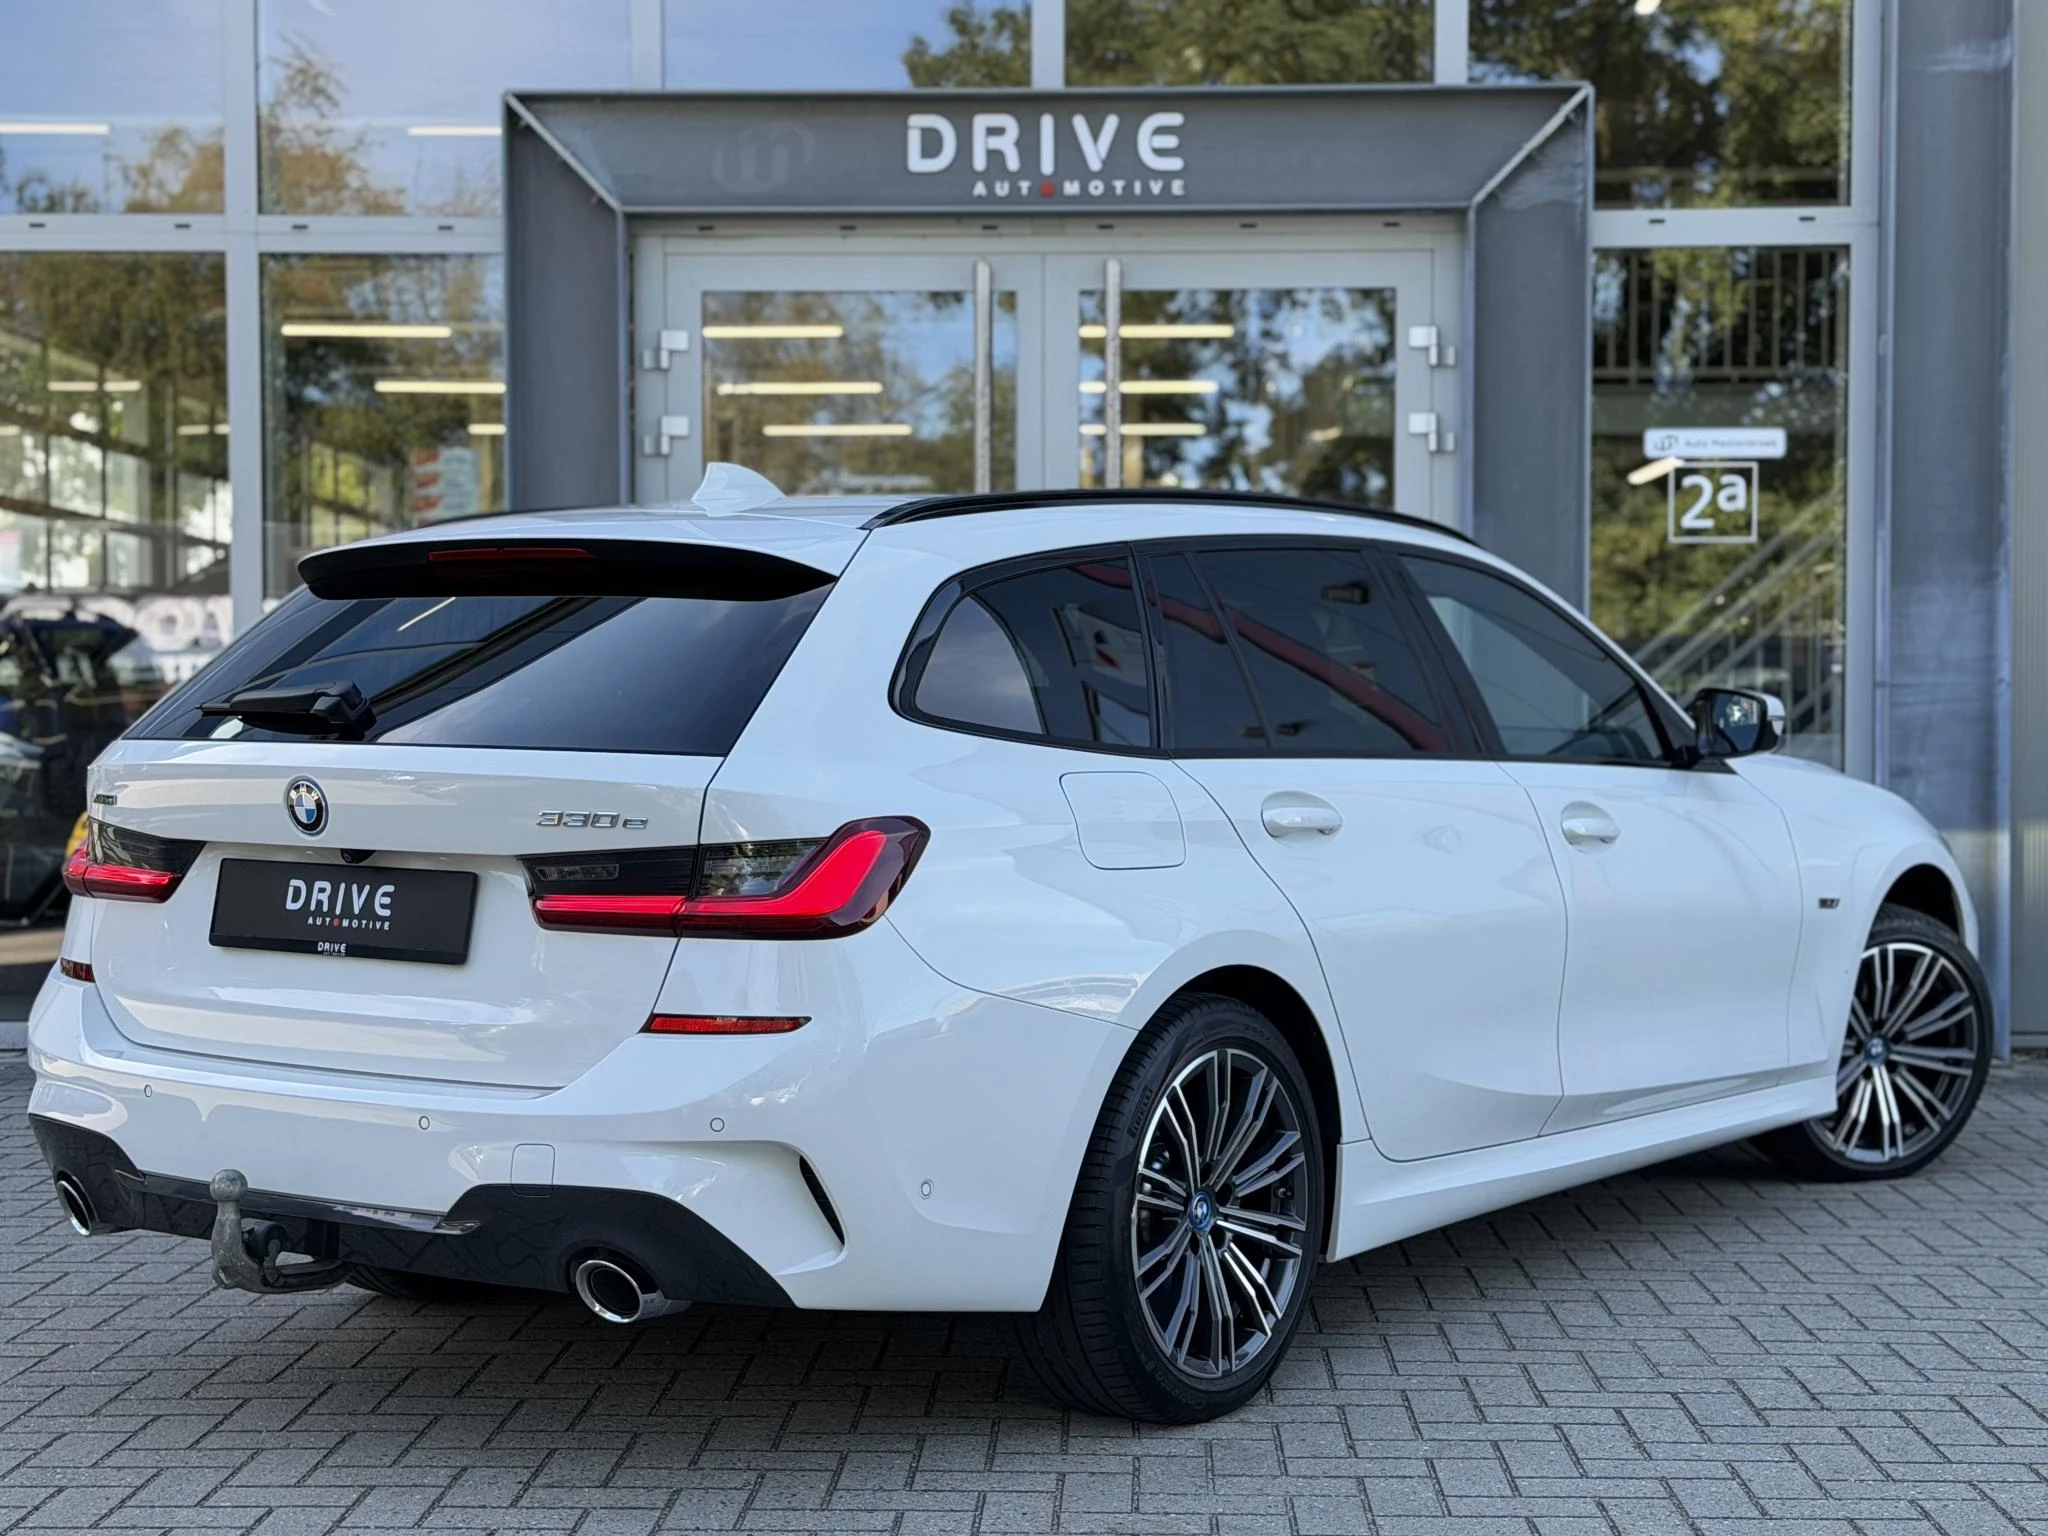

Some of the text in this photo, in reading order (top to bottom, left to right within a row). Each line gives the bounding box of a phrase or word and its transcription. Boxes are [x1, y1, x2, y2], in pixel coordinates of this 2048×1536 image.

[907, 112, 1185, 176] DRIVE
[972, 179, 1185, 197] AUTOMOTIVE
[1680, 473, 1747, 530] 2a
[536, 810, 649, 829] 330e
[285, 878, 396, 917] DRIVE
[307, 916, 391, 931] AUTOMOTIVE
[317, 941, 347, 953] DRIVE
